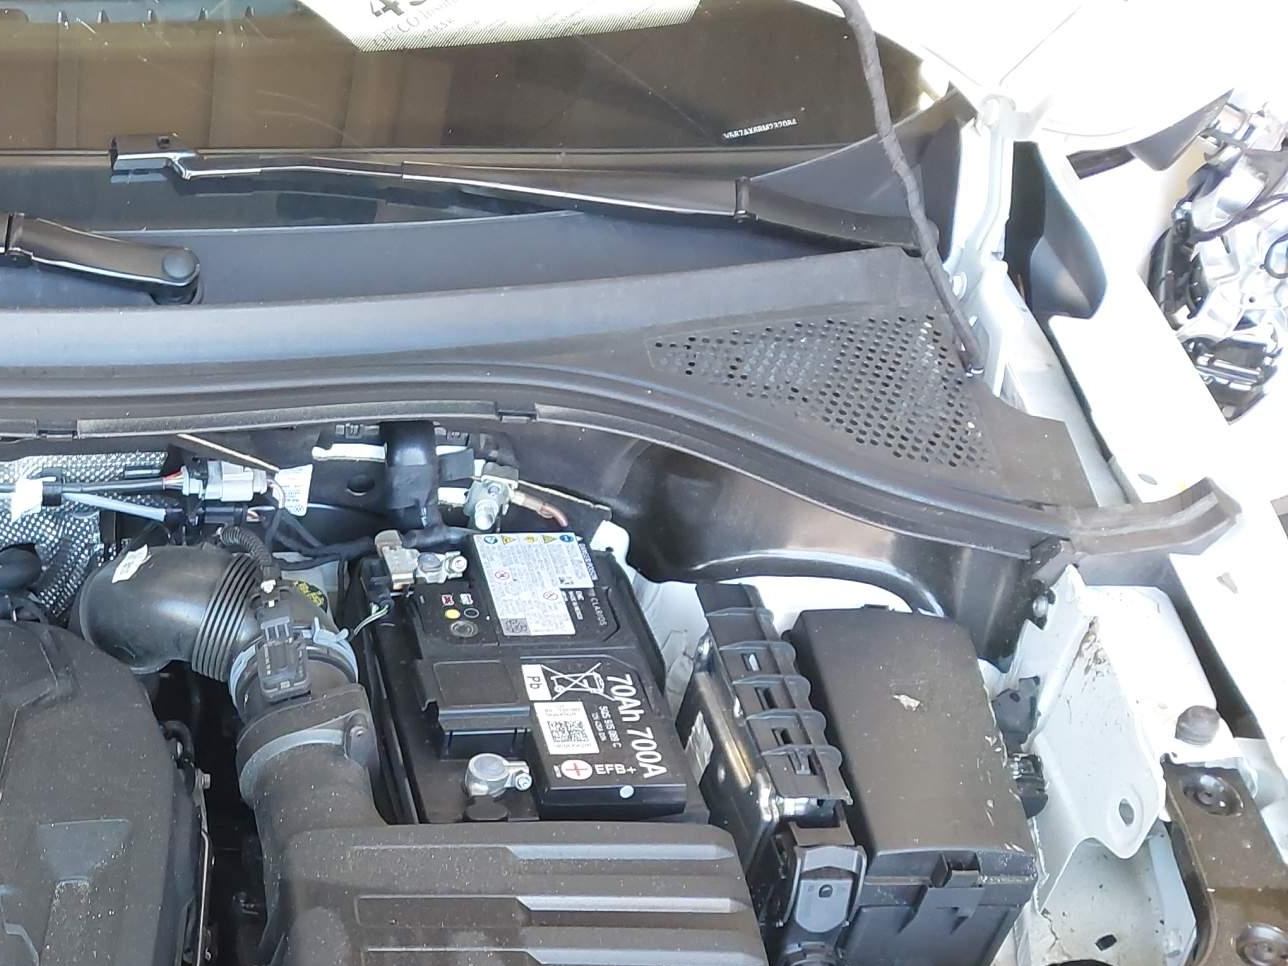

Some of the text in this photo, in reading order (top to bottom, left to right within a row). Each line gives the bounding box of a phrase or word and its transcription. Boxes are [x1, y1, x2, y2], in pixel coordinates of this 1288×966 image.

[527, 676, 541, 690] Pb
[606, 673, 668, 779] 70Ah 700A
[595, 763, 637, 776] EFB+
